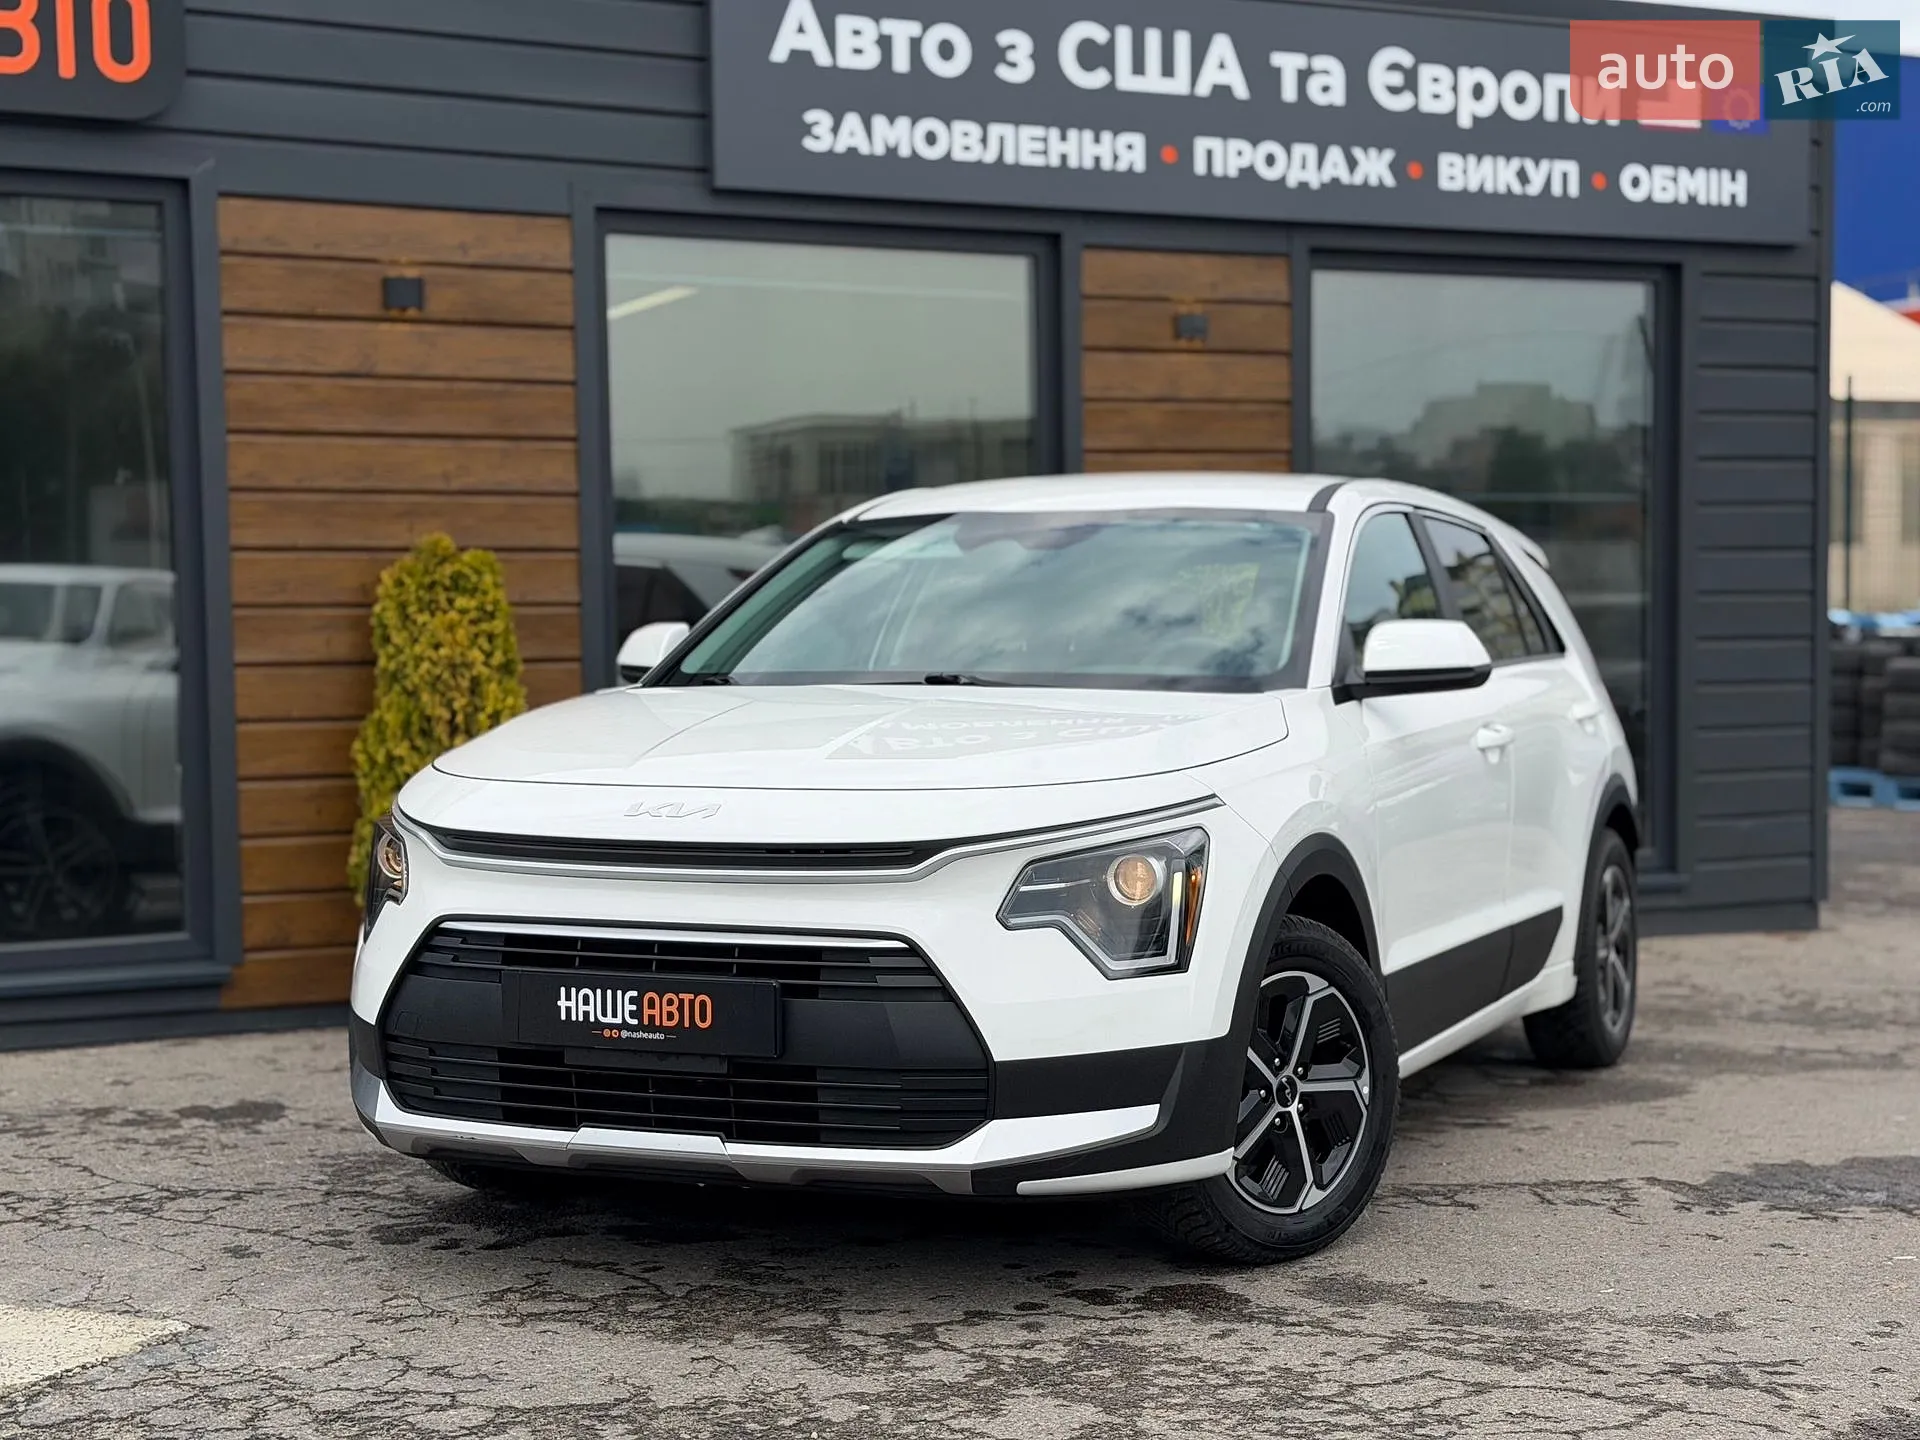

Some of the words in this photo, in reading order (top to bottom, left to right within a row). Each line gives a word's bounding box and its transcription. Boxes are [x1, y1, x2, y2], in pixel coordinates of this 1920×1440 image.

[768, 0, 973, 79] Авто
[1057, 20, 1251, 101] США
[1269, 50, 1347, 108] та
[1367, 46, 1621, 129] Європи
[801, 107, 1147, 174] ЗАМОВЛЕННЯ
[1192, 135, 1398, 191] ПРОДАЖ
[1436, 151, 1581, 200] ВИКУП
[1618, 162, 1748, 208] ОБМІН
[557, 986, 639, 1026] НАШЕ
[642, 991, 713, 1030] АВТО
[620, 1028, 666, 1040] @nasheauto
